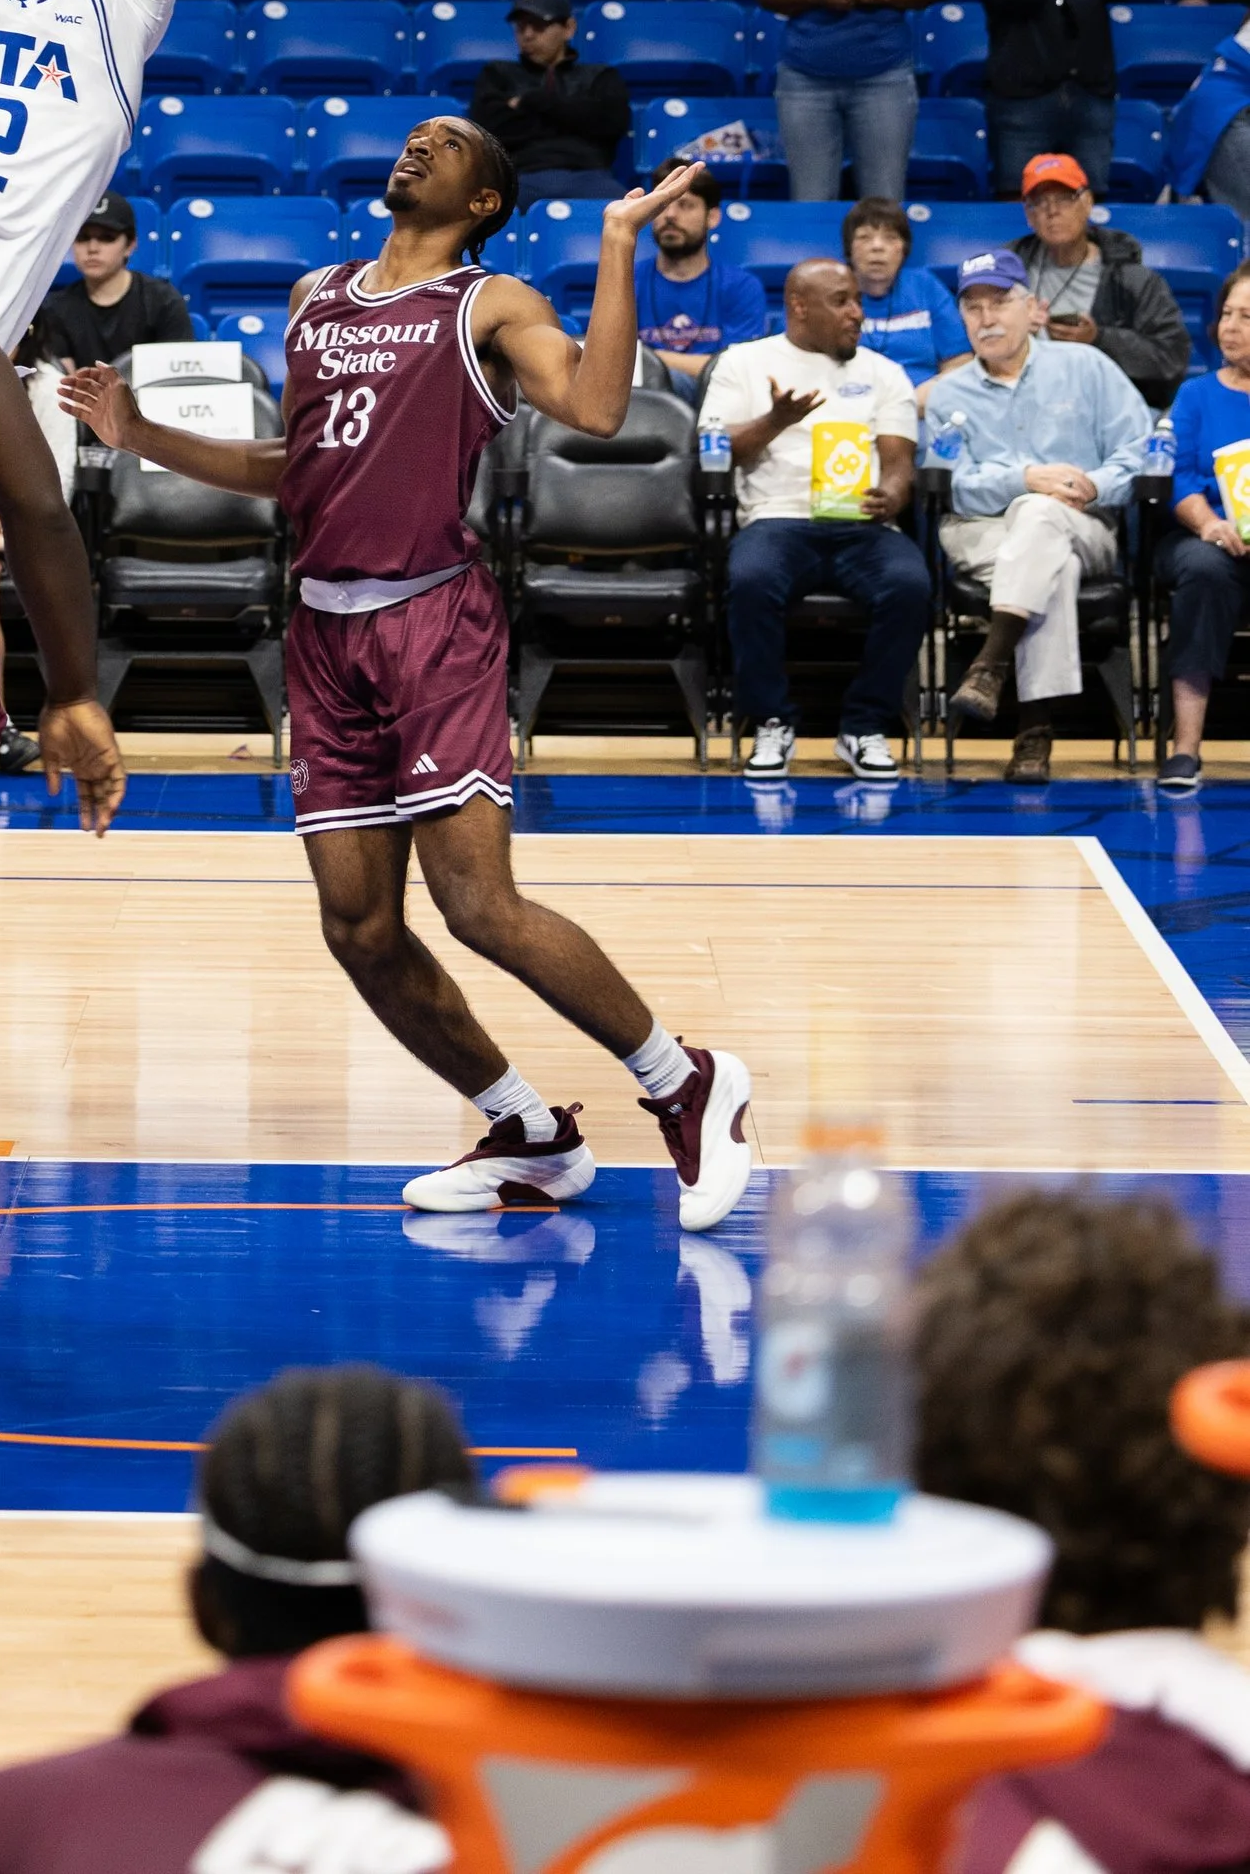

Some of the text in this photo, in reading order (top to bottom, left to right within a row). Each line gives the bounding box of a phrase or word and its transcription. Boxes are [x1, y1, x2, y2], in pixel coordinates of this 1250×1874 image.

[55, 13, 84, 25] WAC
[293, 319, 440, 352] Missouri
[169, 360, 203, 373] UTA
[316, 347, 397, 380] State
[179, 404, 214, 418] UTA
[316, 386, 377, 448] 13
